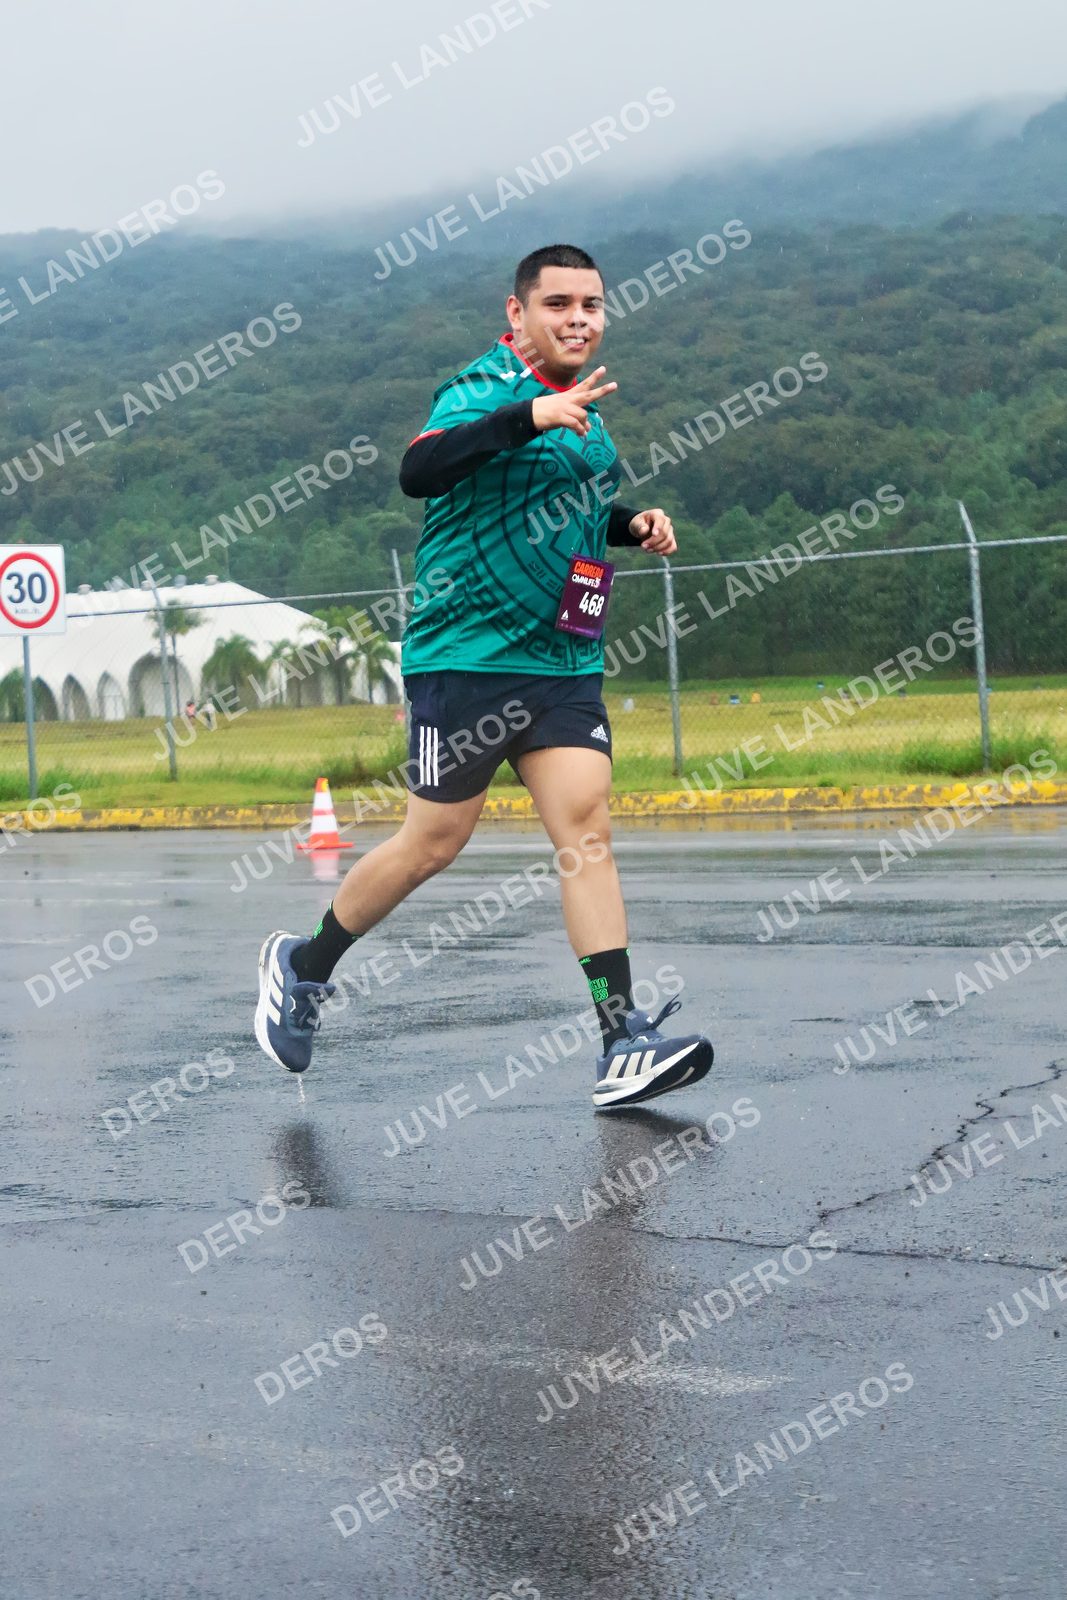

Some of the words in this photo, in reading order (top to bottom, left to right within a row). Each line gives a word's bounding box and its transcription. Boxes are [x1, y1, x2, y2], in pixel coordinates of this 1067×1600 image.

[574, 561, 604, 578] CARRERA
[6, 572, 47, 604] 30
[578, 591, 605, 617] 468
